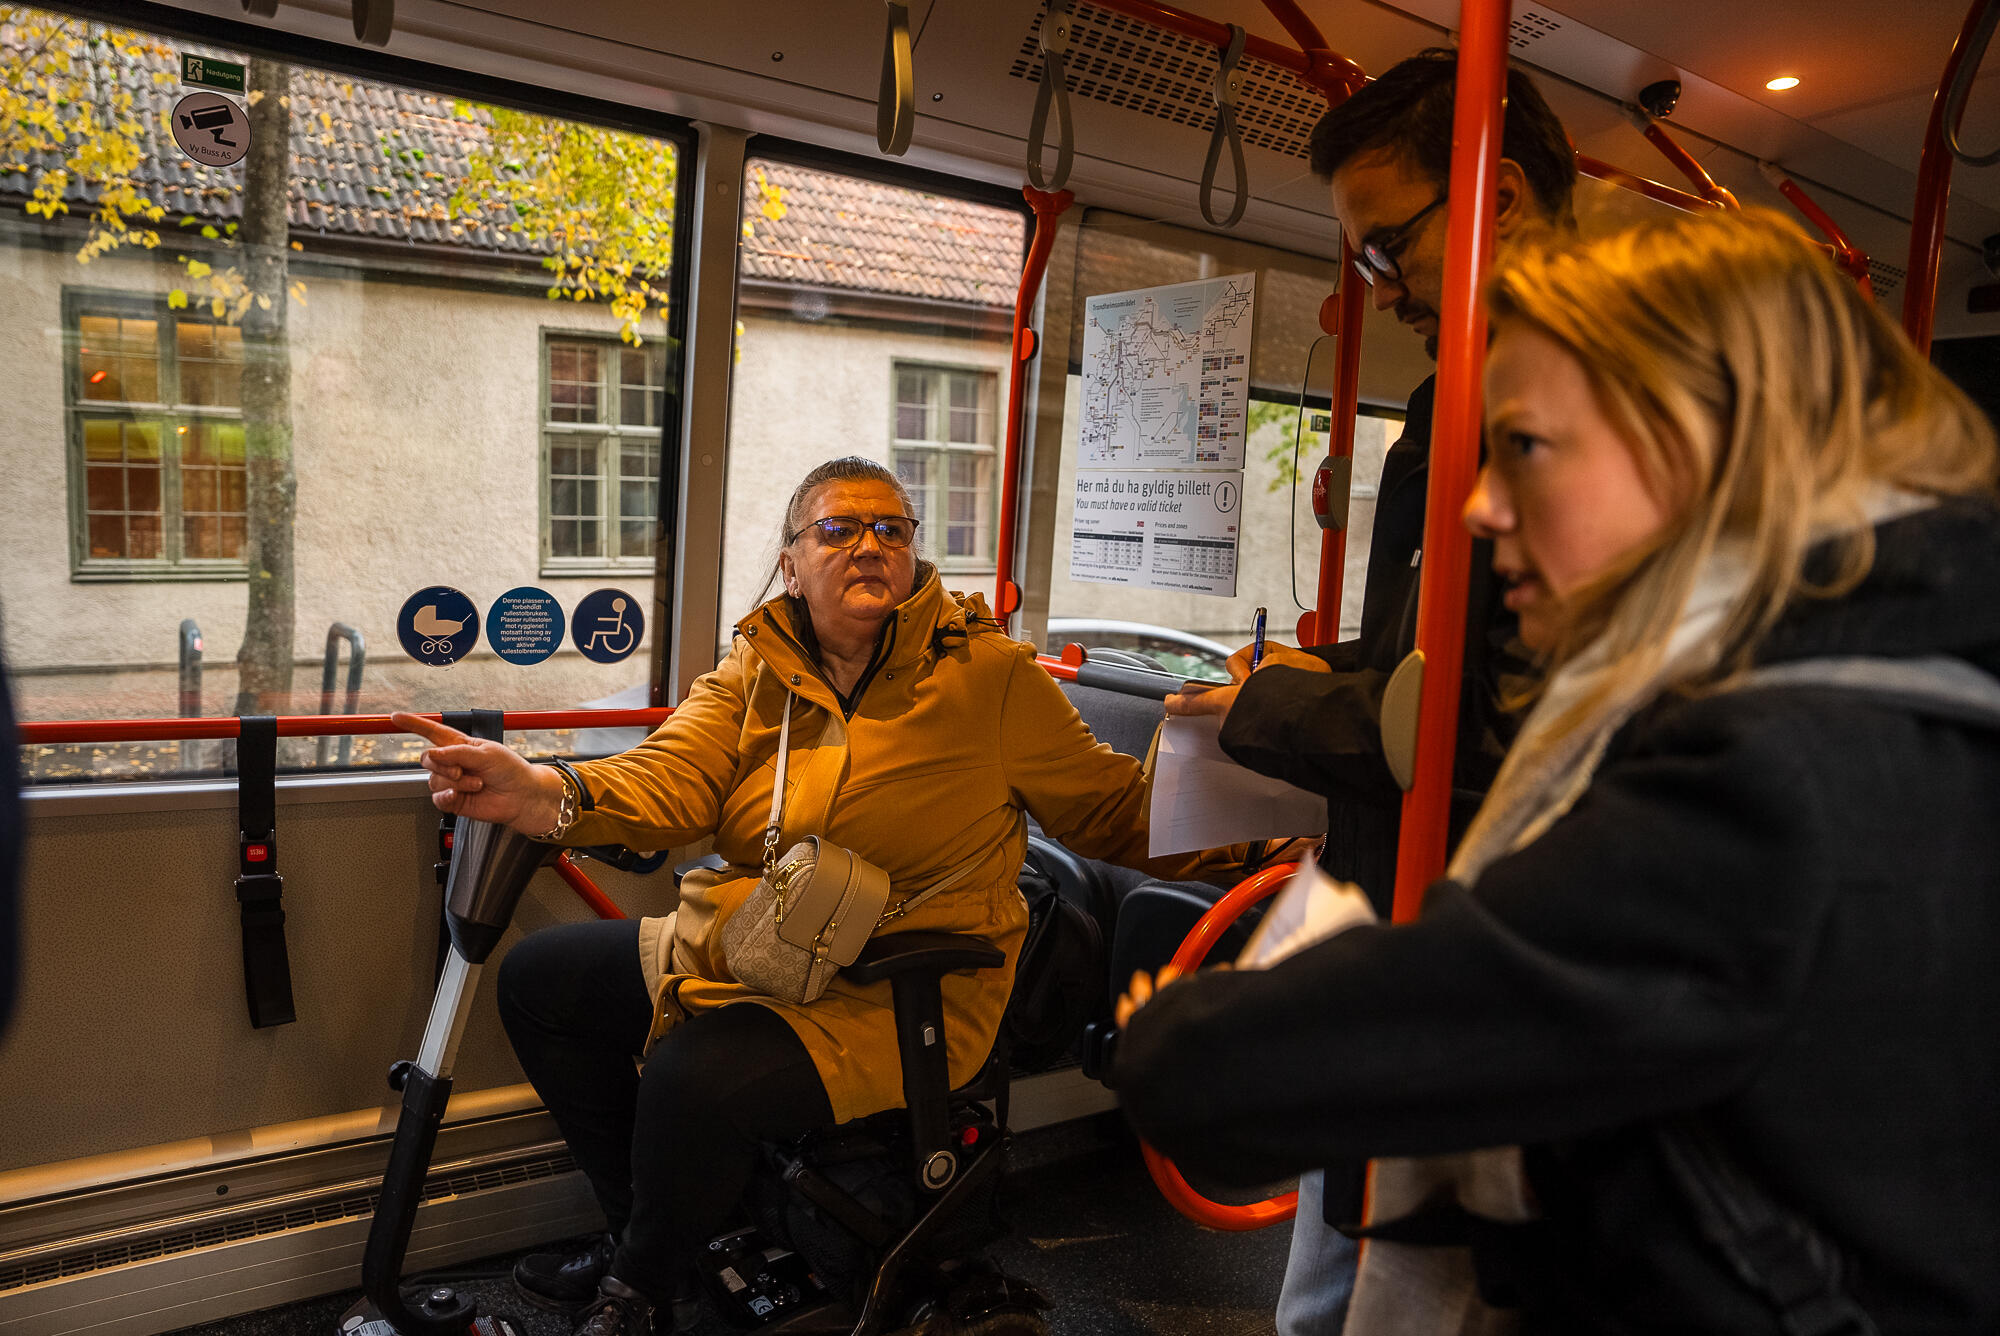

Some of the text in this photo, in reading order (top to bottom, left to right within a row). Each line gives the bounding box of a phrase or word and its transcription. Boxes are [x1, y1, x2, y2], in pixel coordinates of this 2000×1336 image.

[206, 68, 241, 82] Nødutgang
[189, 144, 232, 160] Vy Buss AS
[1077, 478, 1211, 498] Her må du ha gyldig billett
[1076, 498, 1183, 513] You must have a valid ticket
